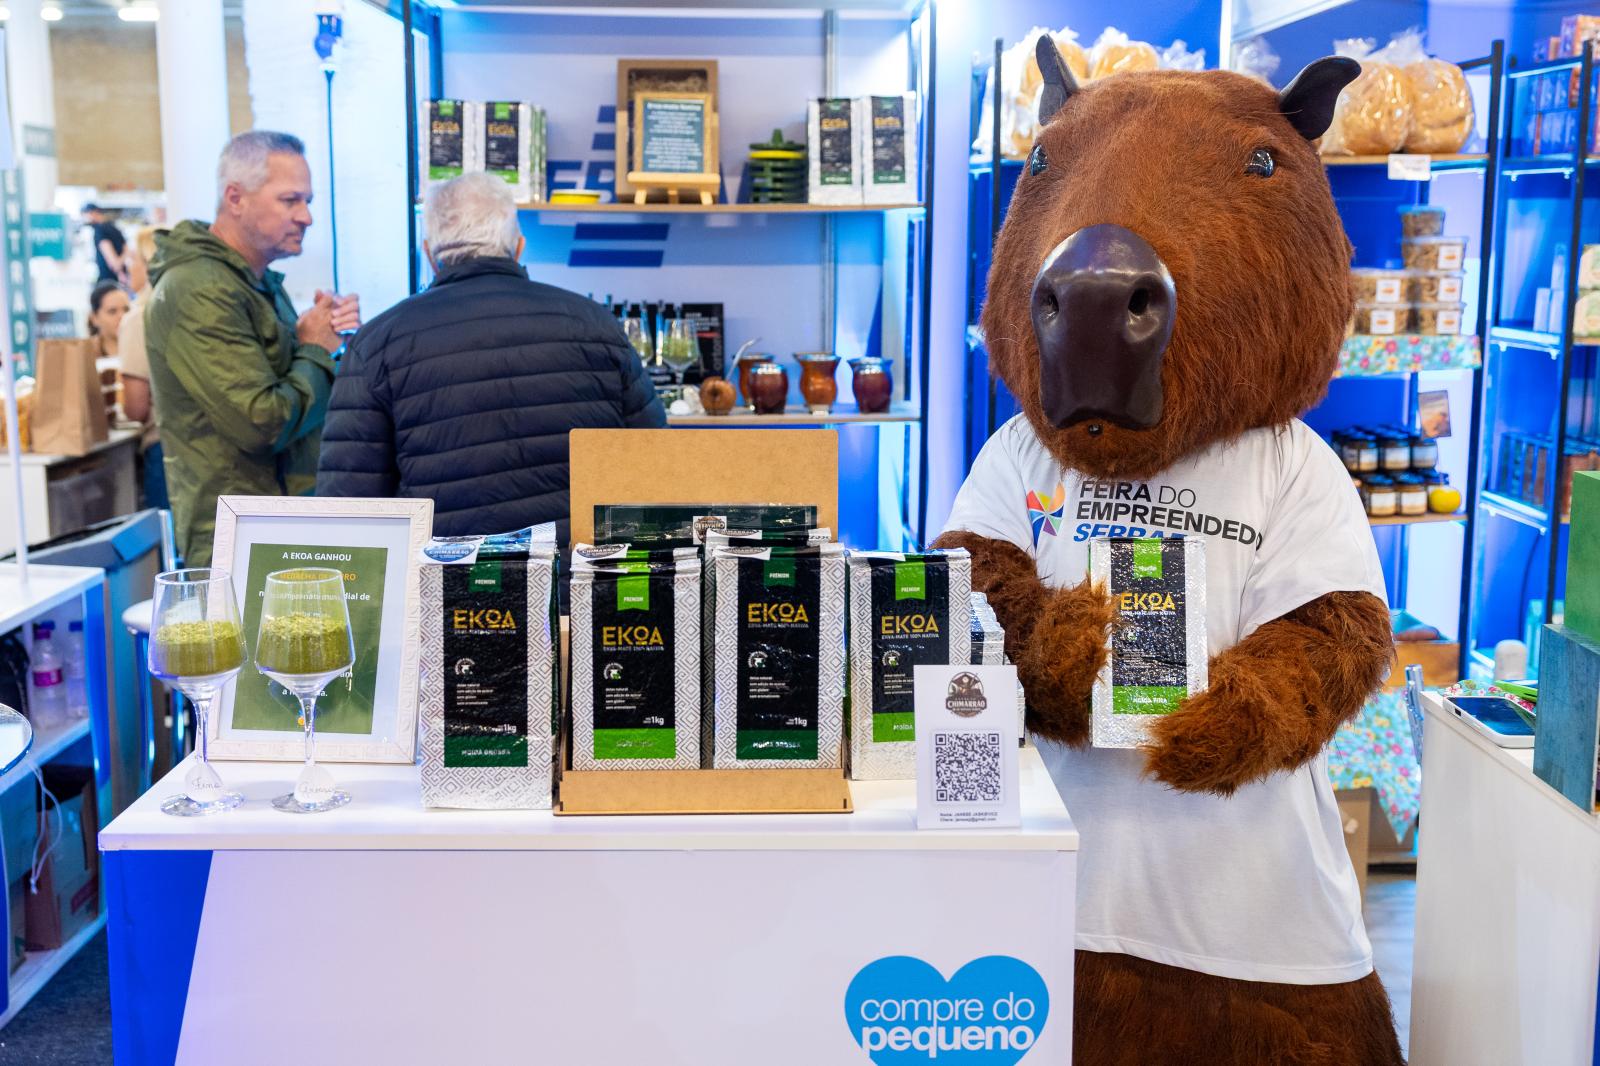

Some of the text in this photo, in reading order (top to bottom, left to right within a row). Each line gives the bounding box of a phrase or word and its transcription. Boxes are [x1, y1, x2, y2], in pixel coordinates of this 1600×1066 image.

[1080, 480, 1197, 508] FEIRA DO
[1073, 523, 1188, 542] SEBR
[290, 552, 313, 560] EKOA
[314, 553, 352, 561] GANHOU
[359, 592, 370, 600] de
[1120, 591, 1176, 611] EKOA
[453, 608, 517, 629] EKOA
[747, 602, 809, 623] EKOA
[881, 614, 939, 635] EKOA
[602, 625, 664, 646] EKOA
[503, 723, 517, 734] 1kg
[651, 716, 665, 726] 1kg
[794, 717, 808, 727] 1kg
[860, 991, 1035, 1024] compre do
[861, 1025, 1035, 1059] pequeno
